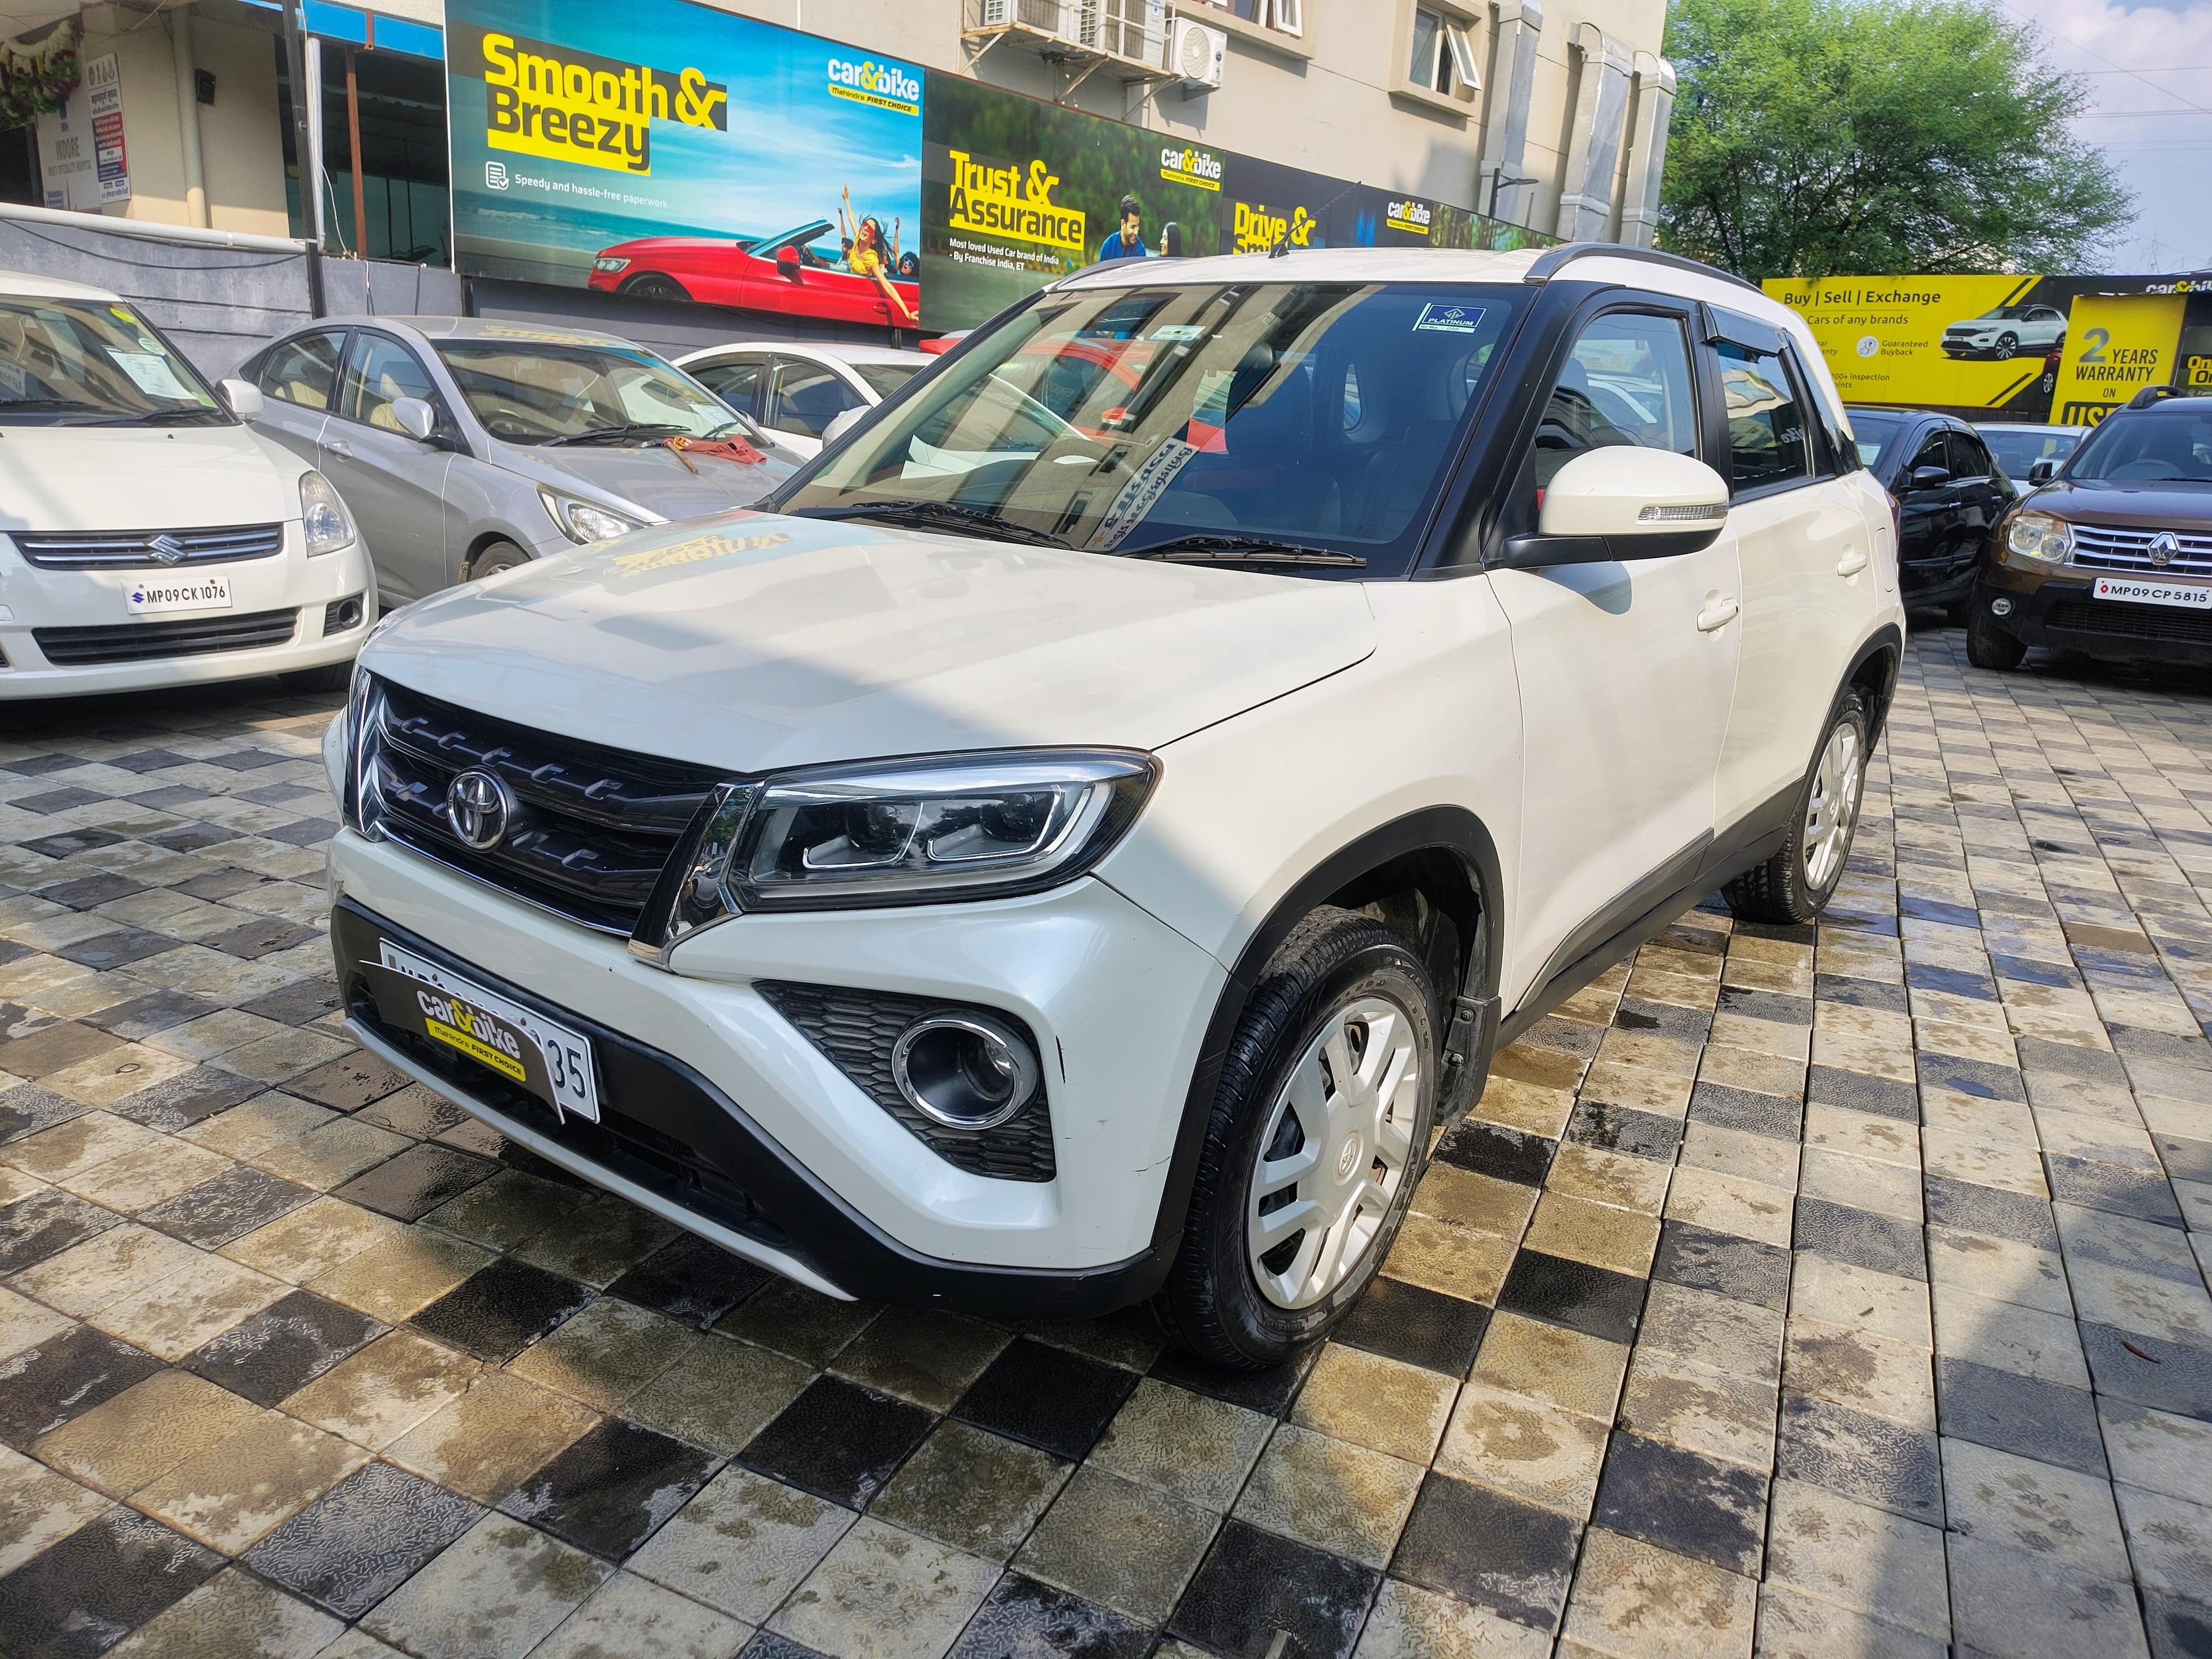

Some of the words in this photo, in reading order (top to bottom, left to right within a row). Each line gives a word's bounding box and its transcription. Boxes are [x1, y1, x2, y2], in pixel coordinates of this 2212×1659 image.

[483, 33, 668, 120] Smooth
[675, 67, 728, 130] &
[828, 59, 920, 101] car&bike
[867, 96, 887, 105] FIRST
[888, 101, 912, 112] CHOICE
[486, 82, 650, 171] Breezy
[55, 137, 80, 161] INDORE
[1161, 148, 1221, 179] car&bike
[515, 174, 550, 190] Speedy
[552, 182, 570, 192] and
[571, 184, 622, 200] hassle-free
[623, 195, 668, 208] paperwork
[949, 150, 1021, 199] Trust
[1025, 159, 1060, 206] &
[950, 187, 1082, 244] Assurance
[1234, 202, 1287, 245] Drive
[1290, 206, 1316, 246] &
[1387, 200, 1430, 225] car&bike
[949, 237, 967, 249] Most
[968, 243, 986, 252] loved
[987, 245, 1004, 255] Used
[1005, 248, 1016, 257] Car
[1017, 250, 1036, 261] brand
[1036, 253, 1044, 262] of
[1044, 255, 1059, 264] India
[954, 251, 963, 263] By
[964, 253, 997, 267] Franchise
[997, 260, 1016, 270] India,
[1016, 262, 1025, 271] ET
[1784, 293, 1811, 306] Buy
[1824, 290, 1852, 303] Sell
[1866, 290, 1941, 306] Exchange
[1428, 318, 1474, 326] PLATINUM
[1807, 315, 1830, 325] Cars
[1833, 314, 1844, 324] of
[1847, 317, 1867, 326] any
[1870, 315, 1908, 324] brands
[1882, 340, 1929, 349] Guaranteed
[2078, 327, 2110, 363] 2
[2111, 349, 2158, 365] YEARS
[1850, 372, 1890, 381] inspection
[2075, 365, 2155, 382] WARRANTY
[2103, 388, 2116, 398] ON
[416, 990, 521, 1059] car&bike
[471, 1043, 493, 1060] FIRST
[494, 1055, 522, 1075] CHOICE
